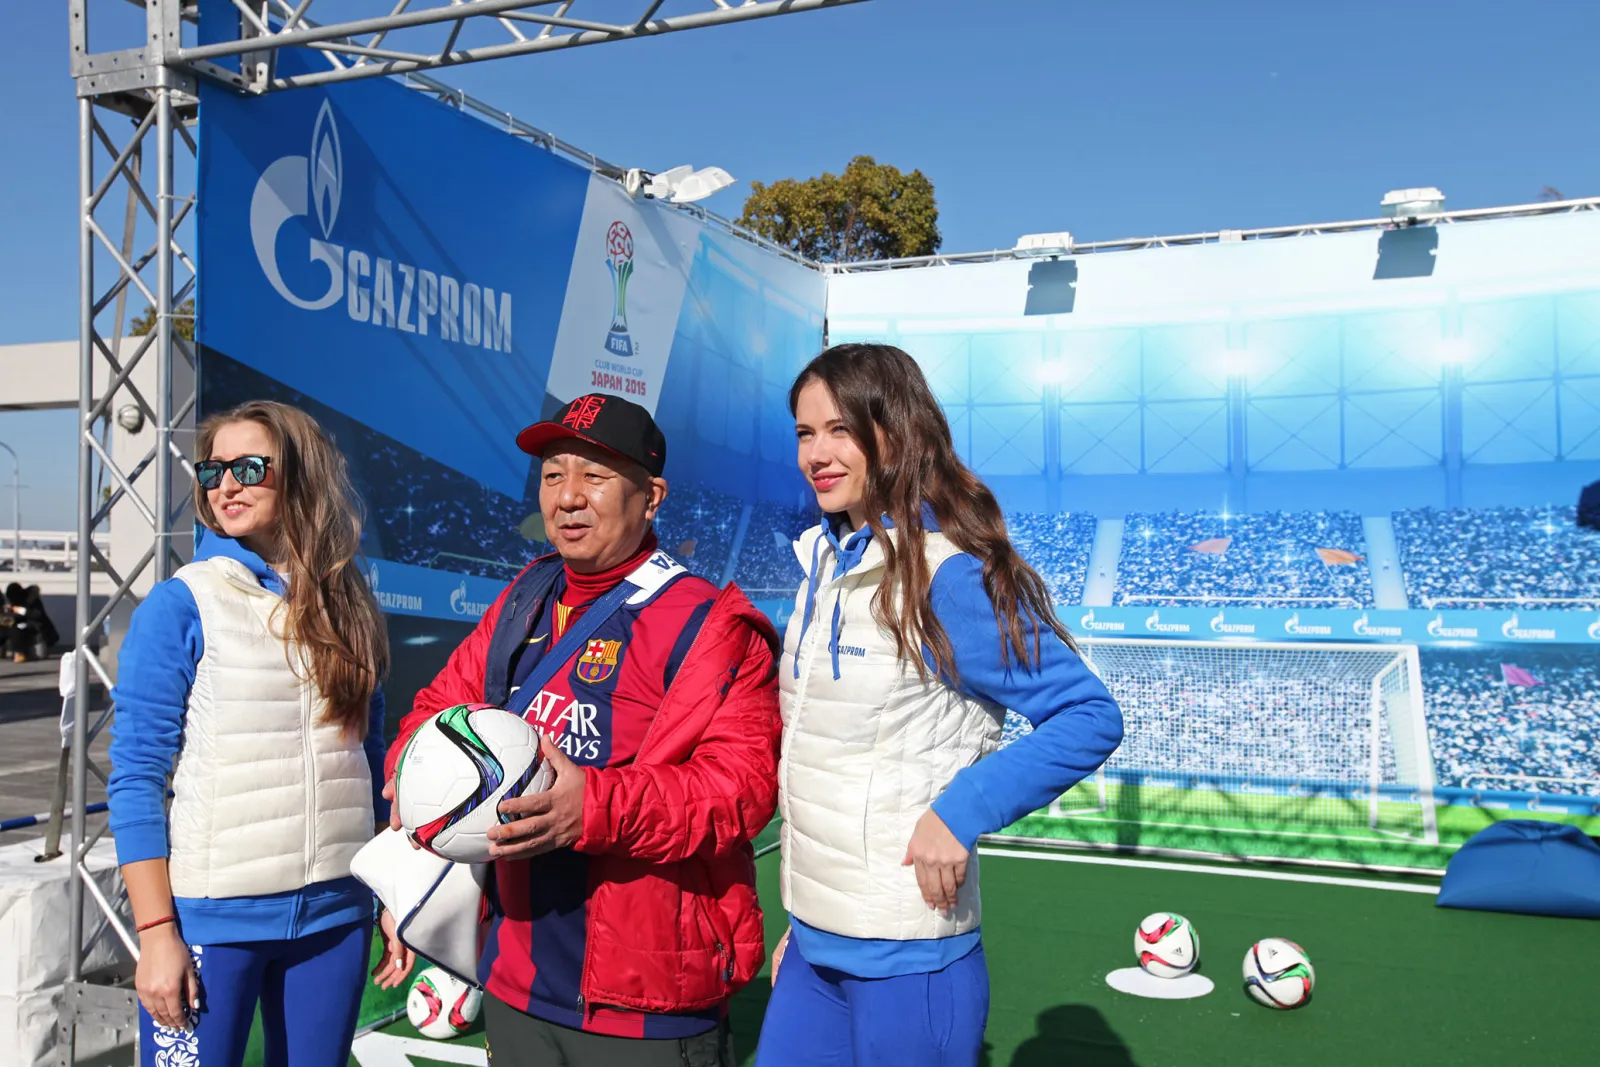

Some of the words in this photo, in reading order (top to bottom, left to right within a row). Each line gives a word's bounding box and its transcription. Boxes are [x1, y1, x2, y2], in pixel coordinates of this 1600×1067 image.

[347, 249, 513, 354] GAZPROM
[611, 337, 628, 353] FIFA
[595, 359, 610, 370] CLUB
[611, 363, 632, 374] WORLD
[632, 368, 643, 377] CUP
[591, 370, 622, 391] JAPAN
[625, 378, 646, 396] 2015
[379, 592, 422, 611] GAZPROM
[510, 686, 602, 737] ATAR
